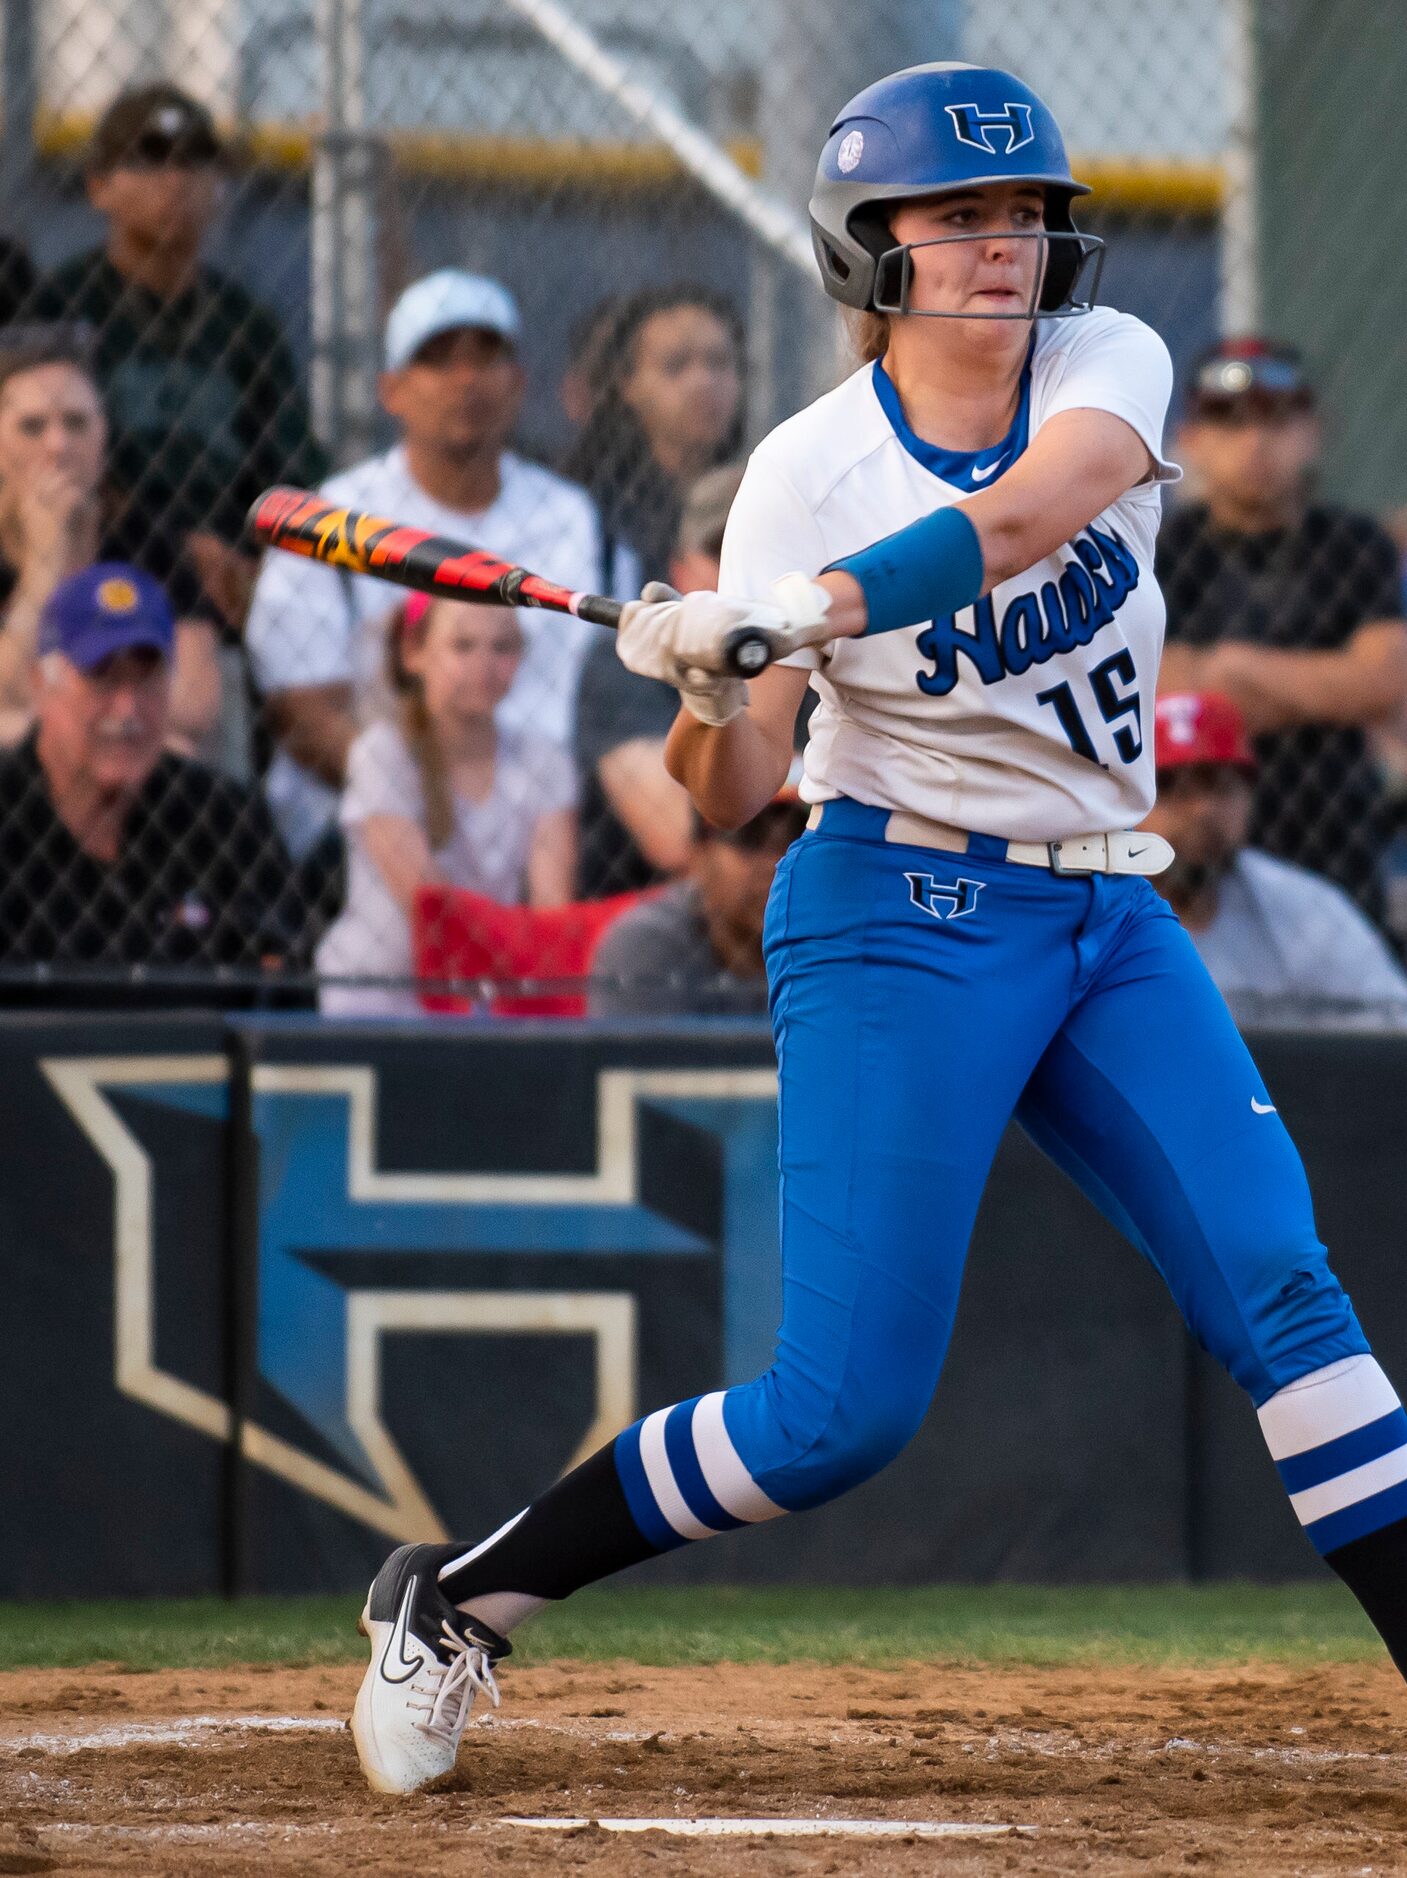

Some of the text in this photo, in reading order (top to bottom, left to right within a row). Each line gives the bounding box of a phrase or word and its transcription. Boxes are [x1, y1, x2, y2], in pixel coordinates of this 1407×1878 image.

[944, 103, 1034, 154] H
[1036, 647, 1142, 770] 15
[902, 872, 987, 919] H
